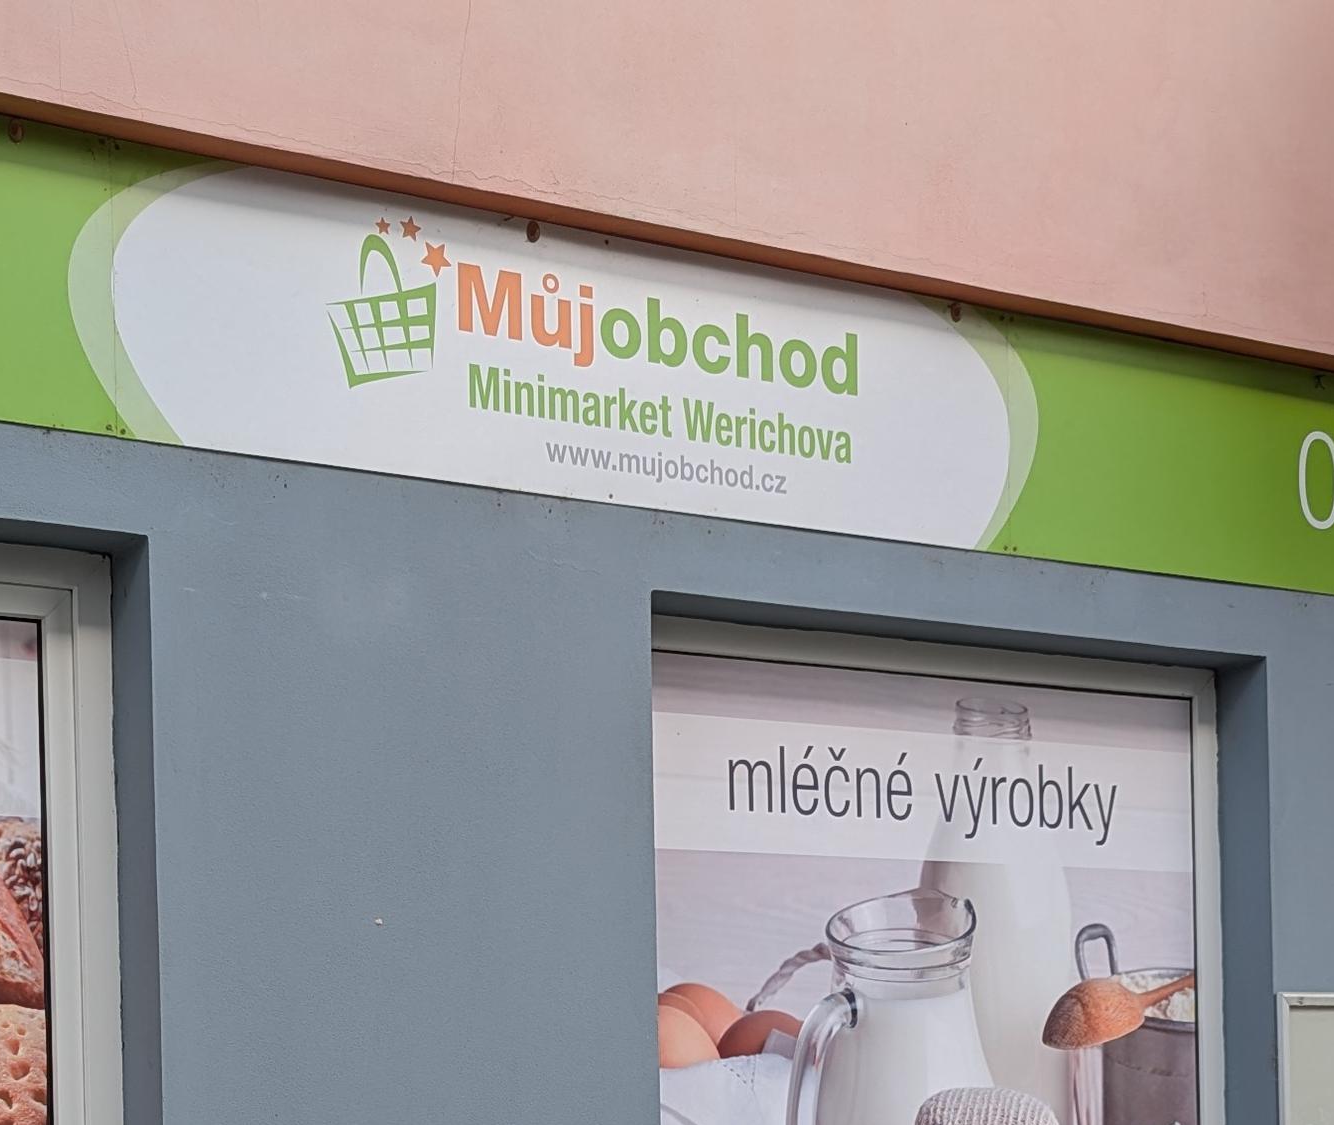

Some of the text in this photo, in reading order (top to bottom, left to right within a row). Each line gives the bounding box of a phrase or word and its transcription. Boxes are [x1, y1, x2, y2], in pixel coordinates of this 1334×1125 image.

[457, 262, 859, 397] Můjobchod
[468, 363, 853, 464] Minimarket Werichova
[545, 440, 788, 495] www.mujobchod.cz
[727, 745, 1118, 847] mléčné výrobky
